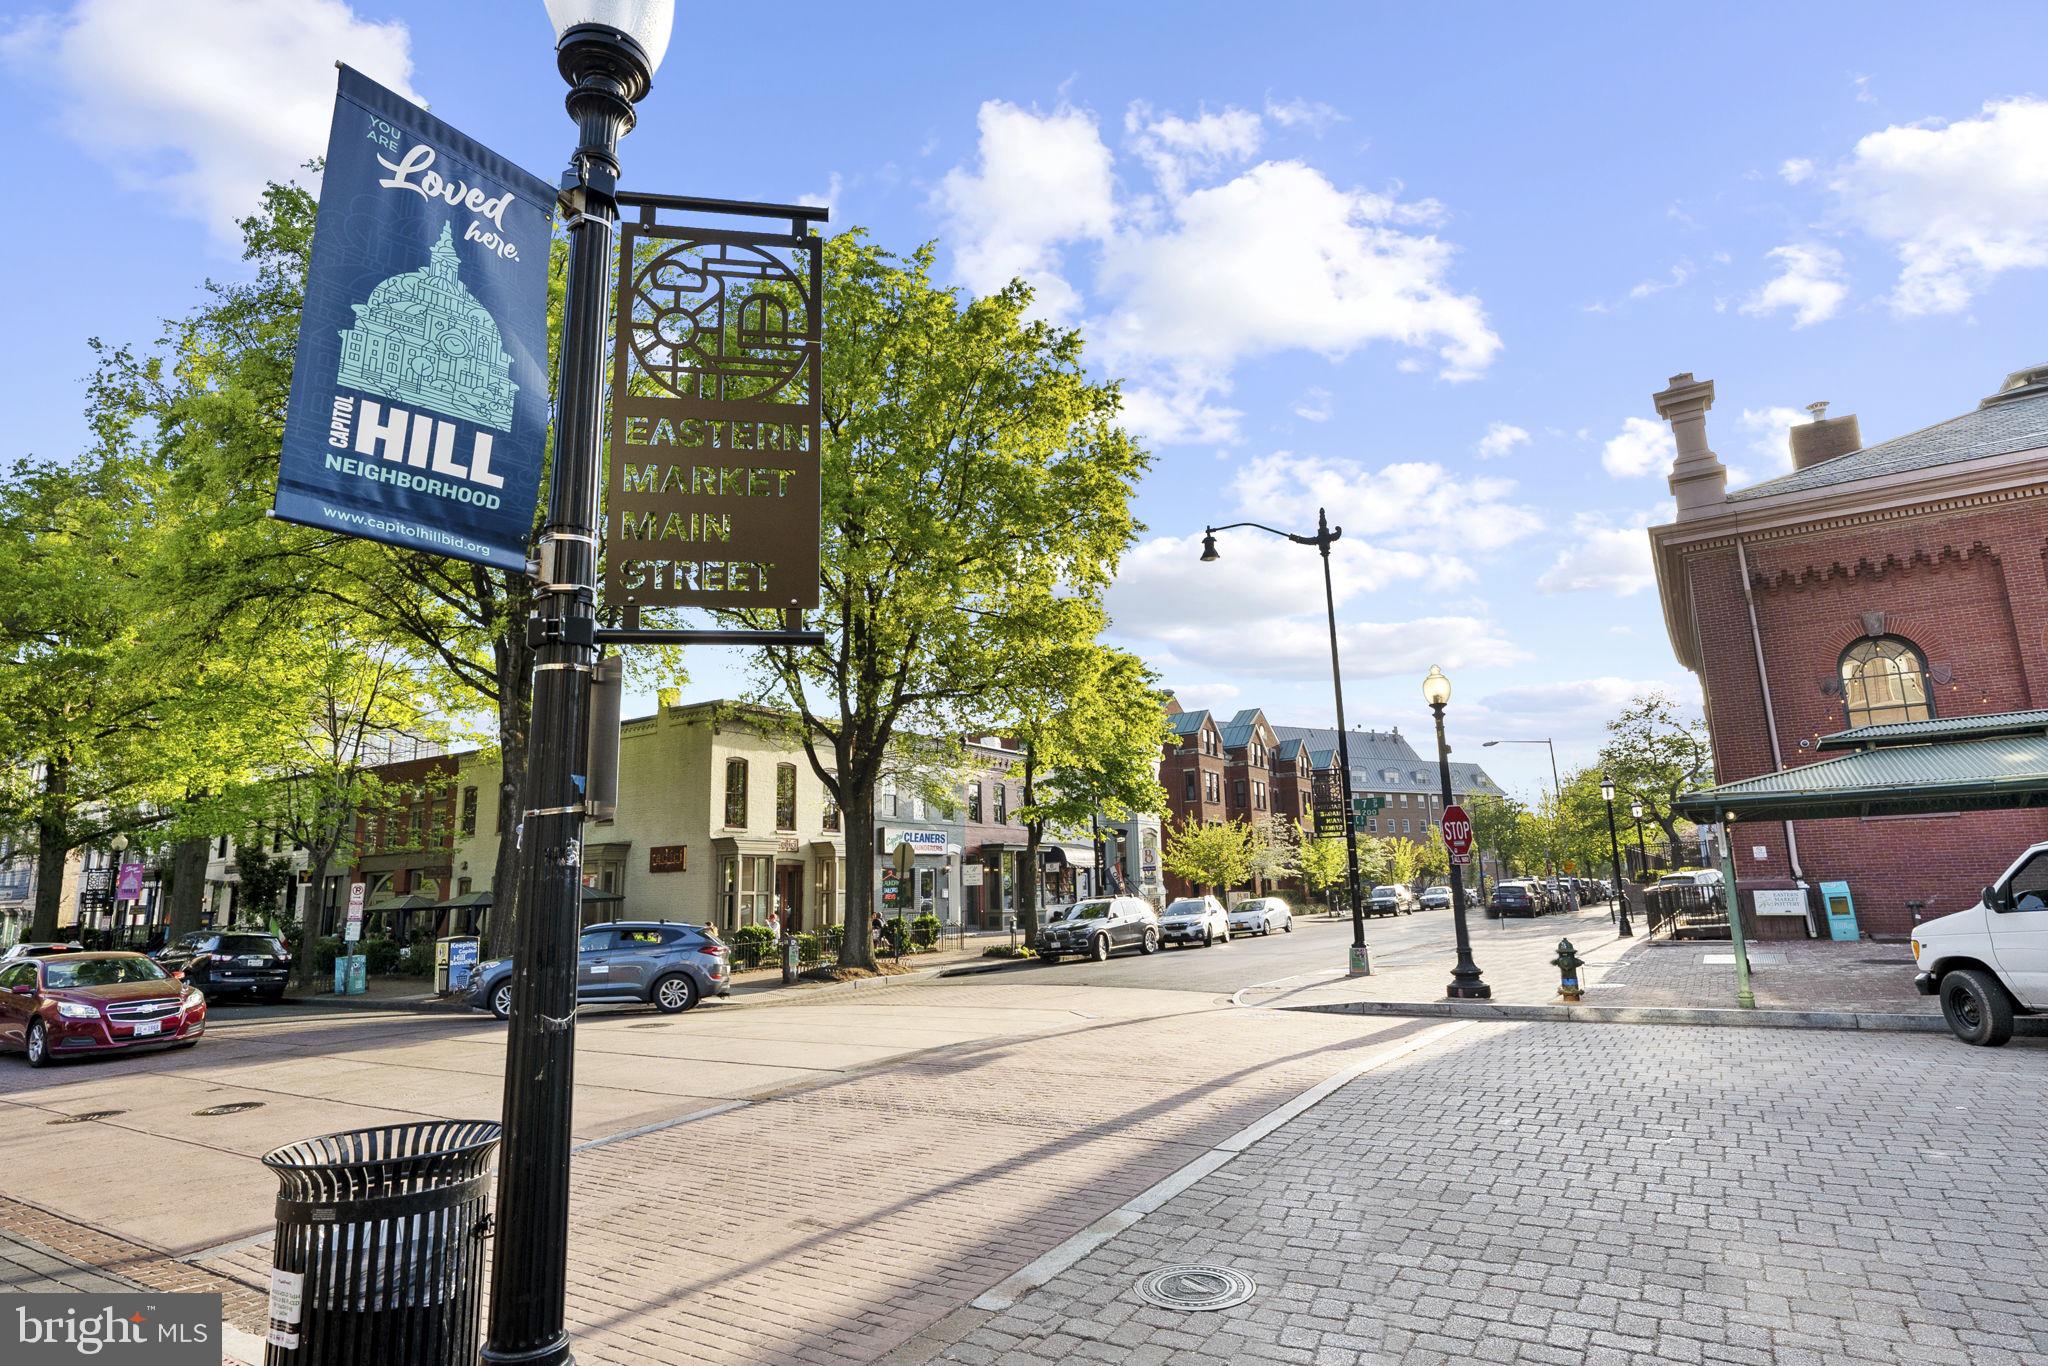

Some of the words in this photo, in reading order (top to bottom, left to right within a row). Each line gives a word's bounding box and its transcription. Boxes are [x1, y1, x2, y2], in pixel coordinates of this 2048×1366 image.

[366, 130, 398, 153] ARE
[370, 114, 401, 140] YOU
[376, 144, 515, 233] Loved
[463, 220, 520, 263] here.
[328, 395, 354, 449] CAPITOL
[625, 416, 810, 452] EASTERN
[354, 399, 504, 489] HILL
[324, 453, 501, 510] NEIGHBORHOOD
[623, 463, 797, 497] MARKET
[322, 506, 491, 556] www.capitolhillbid.org
[621, 511, 732, 542] MAIN
[619, 559, 775, 592] STREET
[904, 832, 946, 844] CLEANERS
[1444, 821, 1470, 840] STOP
